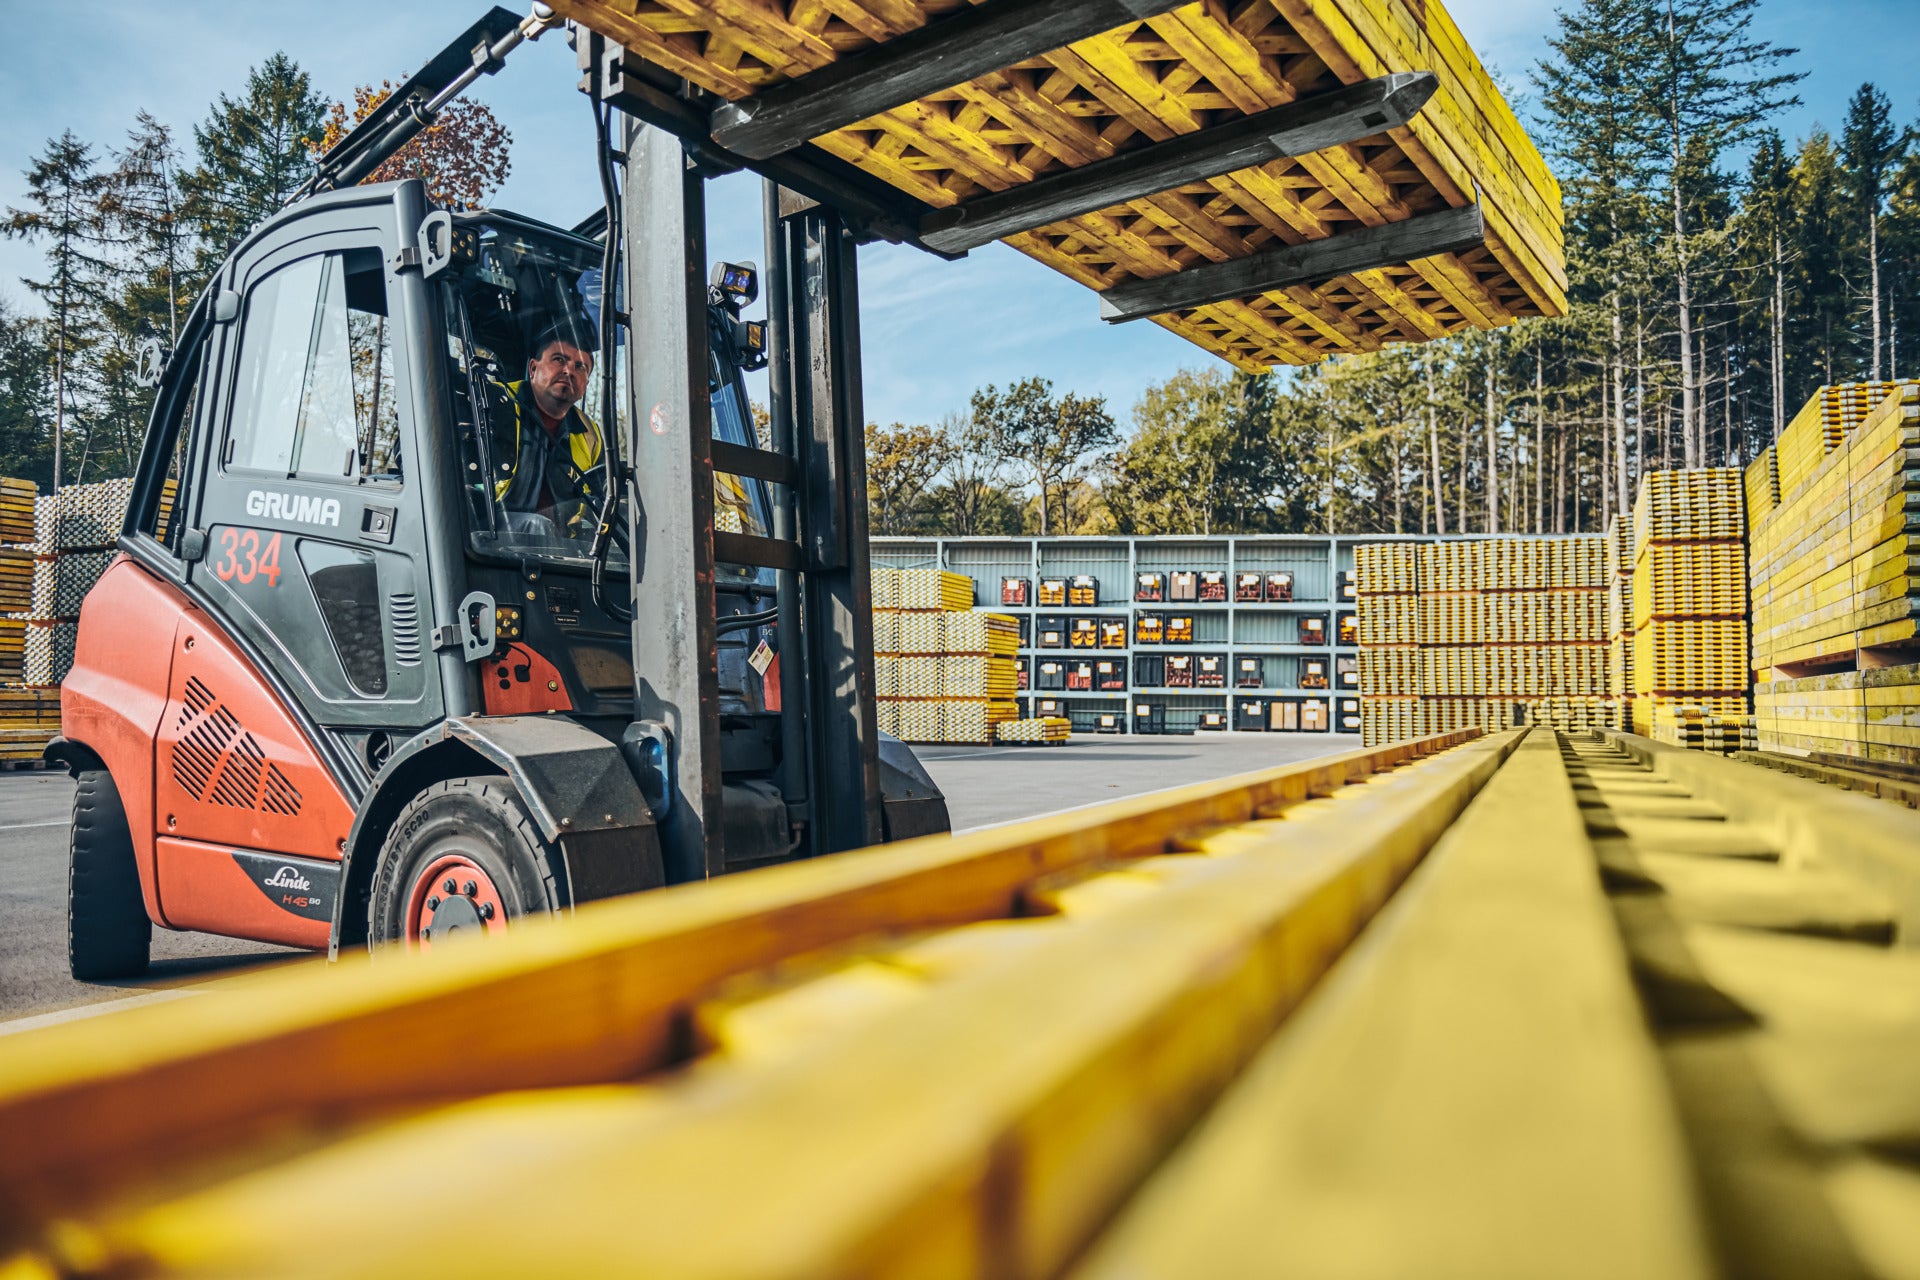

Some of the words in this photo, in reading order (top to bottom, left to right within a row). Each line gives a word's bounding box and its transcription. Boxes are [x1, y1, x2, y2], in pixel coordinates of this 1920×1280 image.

[246, 490, 341, 527] GRUMA
[216, 527, 282, 588] 334
[404, 809, 429, 840] SC20
[264, 866, 311, 891] Linde
